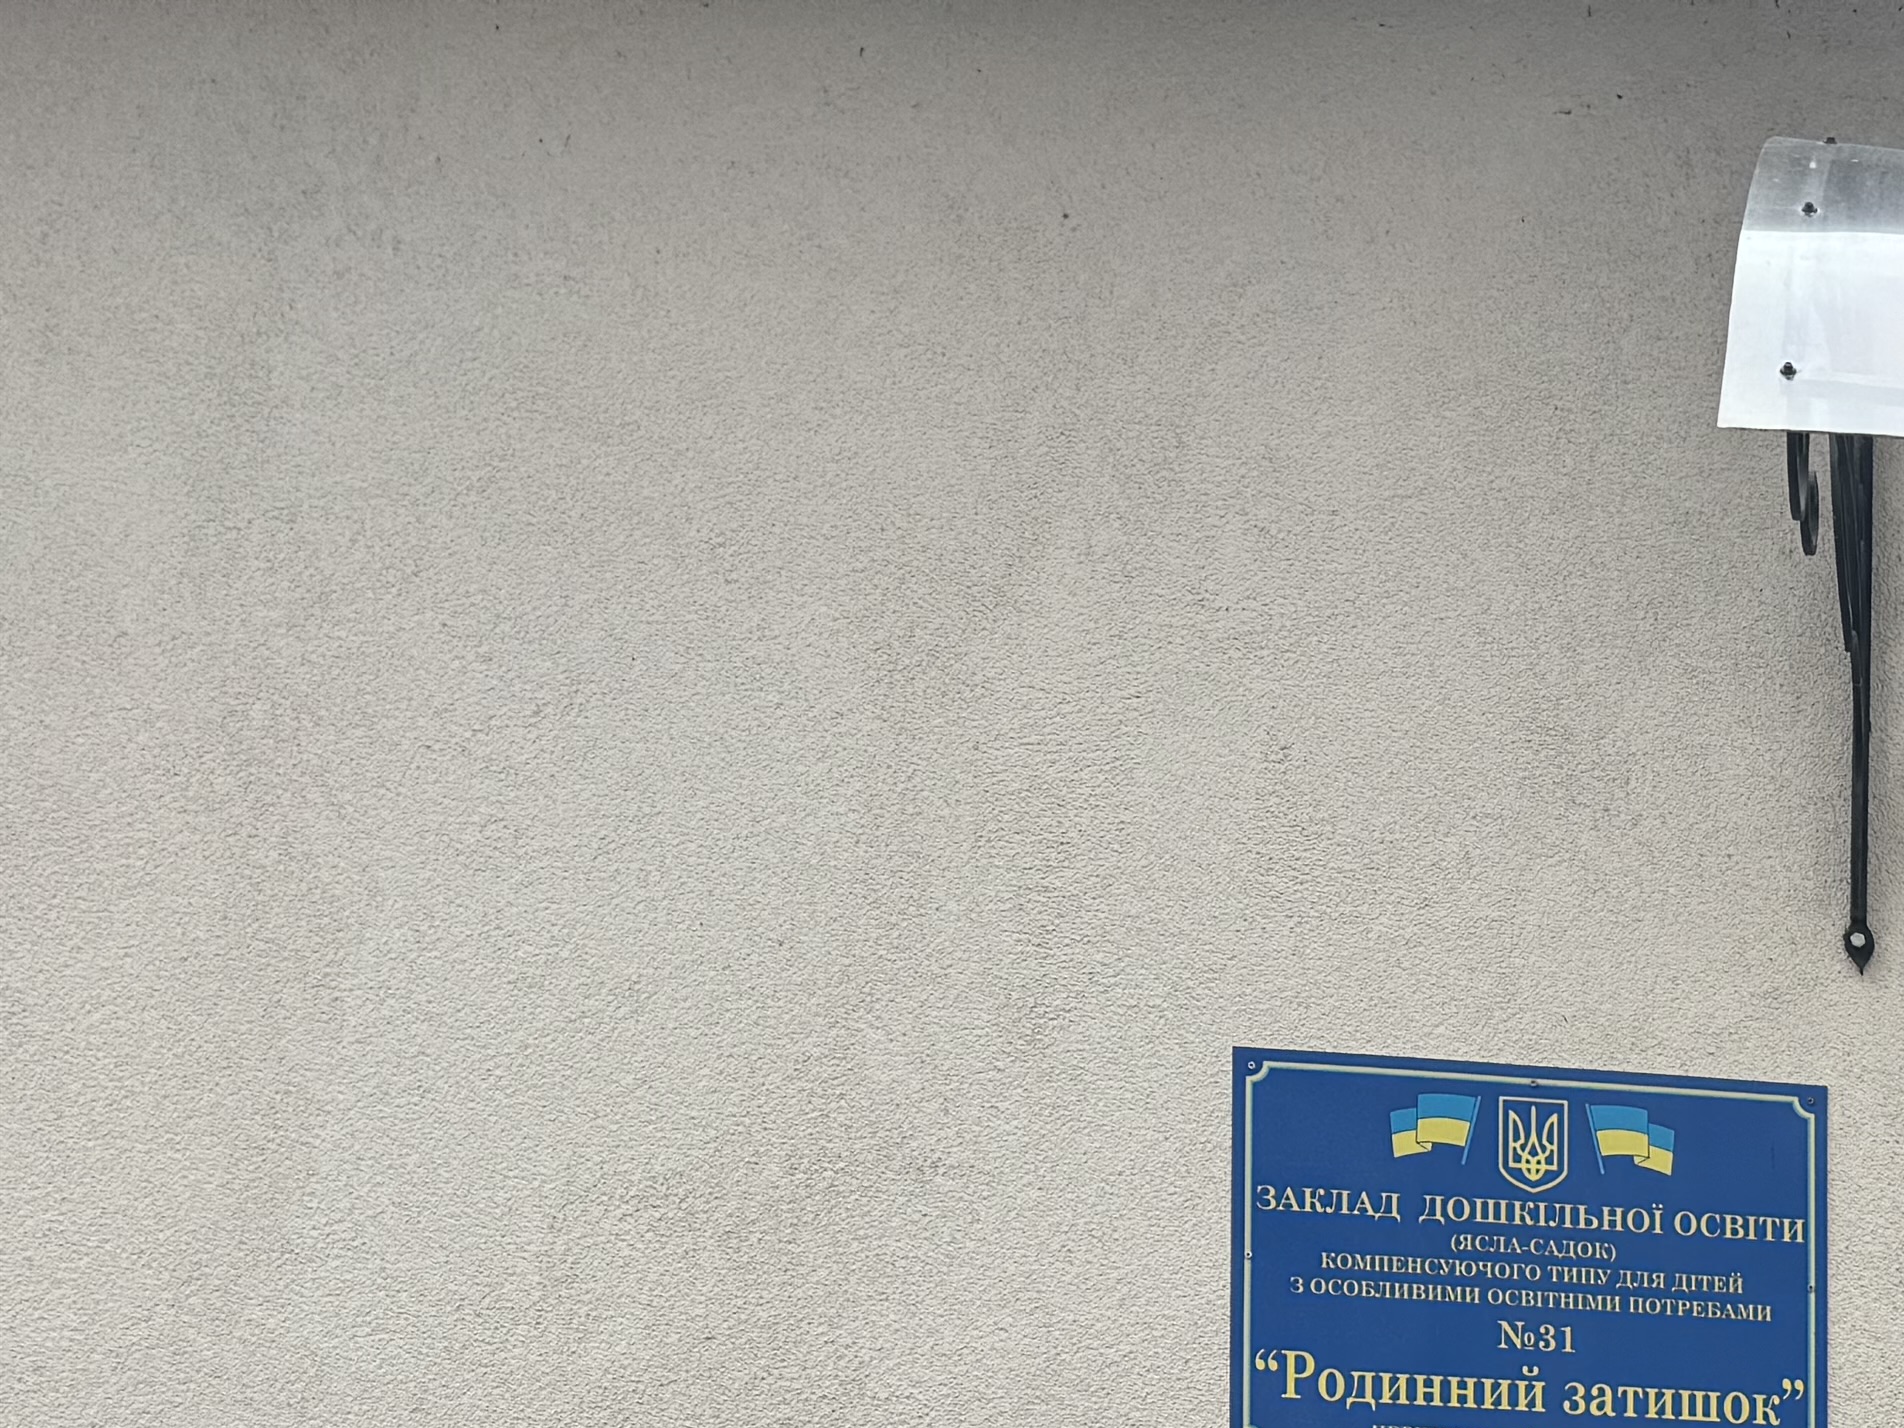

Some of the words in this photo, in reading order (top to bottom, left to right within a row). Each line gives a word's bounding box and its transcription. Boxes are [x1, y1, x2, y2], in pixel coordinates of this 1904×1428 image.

[1256, 1184, 1401, 1223] ЗАКЛАД
[1418, 1194, 1664, 1235] ДОШКІЛЬНОЇ
[1673, 1210, 1805, 1243] ОСВІТИ
[1451, 1233, 1617, 1263] (ЯСЛА-САДОК)
[1320, 1252, 1541, 1283] КОМПЕНСУЮЧОГО
[1547, 1265, 1611, 1285] ТИПУ
[1615, 1269, 1666, 1290] ДЛЯ
[1671, 1272, 1744, 1295] ДІТЕЙ
[1289, 1276, 1304, 1294] З
[1310, 1277, 1480, 1304] ОСОБЛИВИМИ
[1487, 1288, 1621, 1313] ОСВІТНІМИ
[1628, 1296, 1772, 1323] ПОТРЕБАМИ
[1497, 1320, 1576, 1354] №31
